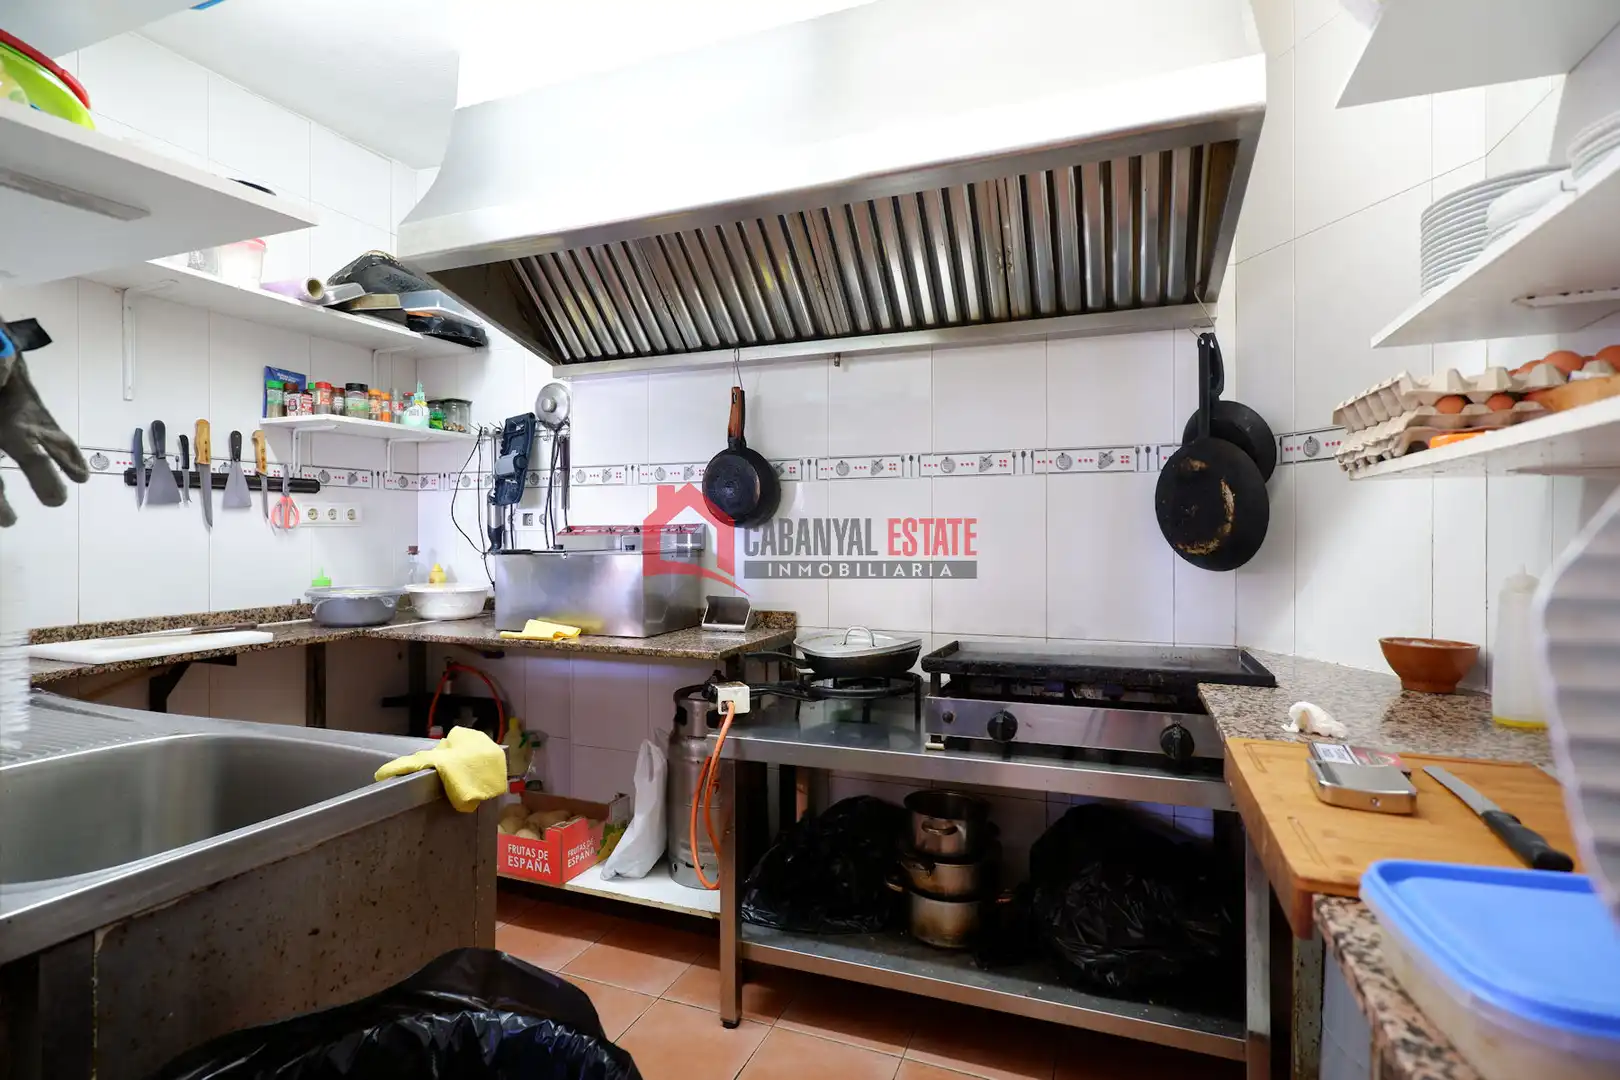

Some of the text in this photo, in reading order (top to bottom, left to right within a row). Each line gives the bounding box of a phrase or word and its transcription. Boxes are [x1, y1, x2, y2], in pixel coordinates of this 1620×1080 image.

[508, 844, 549, 861] FRUTAS DE
[567, 841, 586, 858] FRUTAS
[567, 847, 595, 868] ESPAÑA
[508, 856, 550, 874] ESPAÑA
